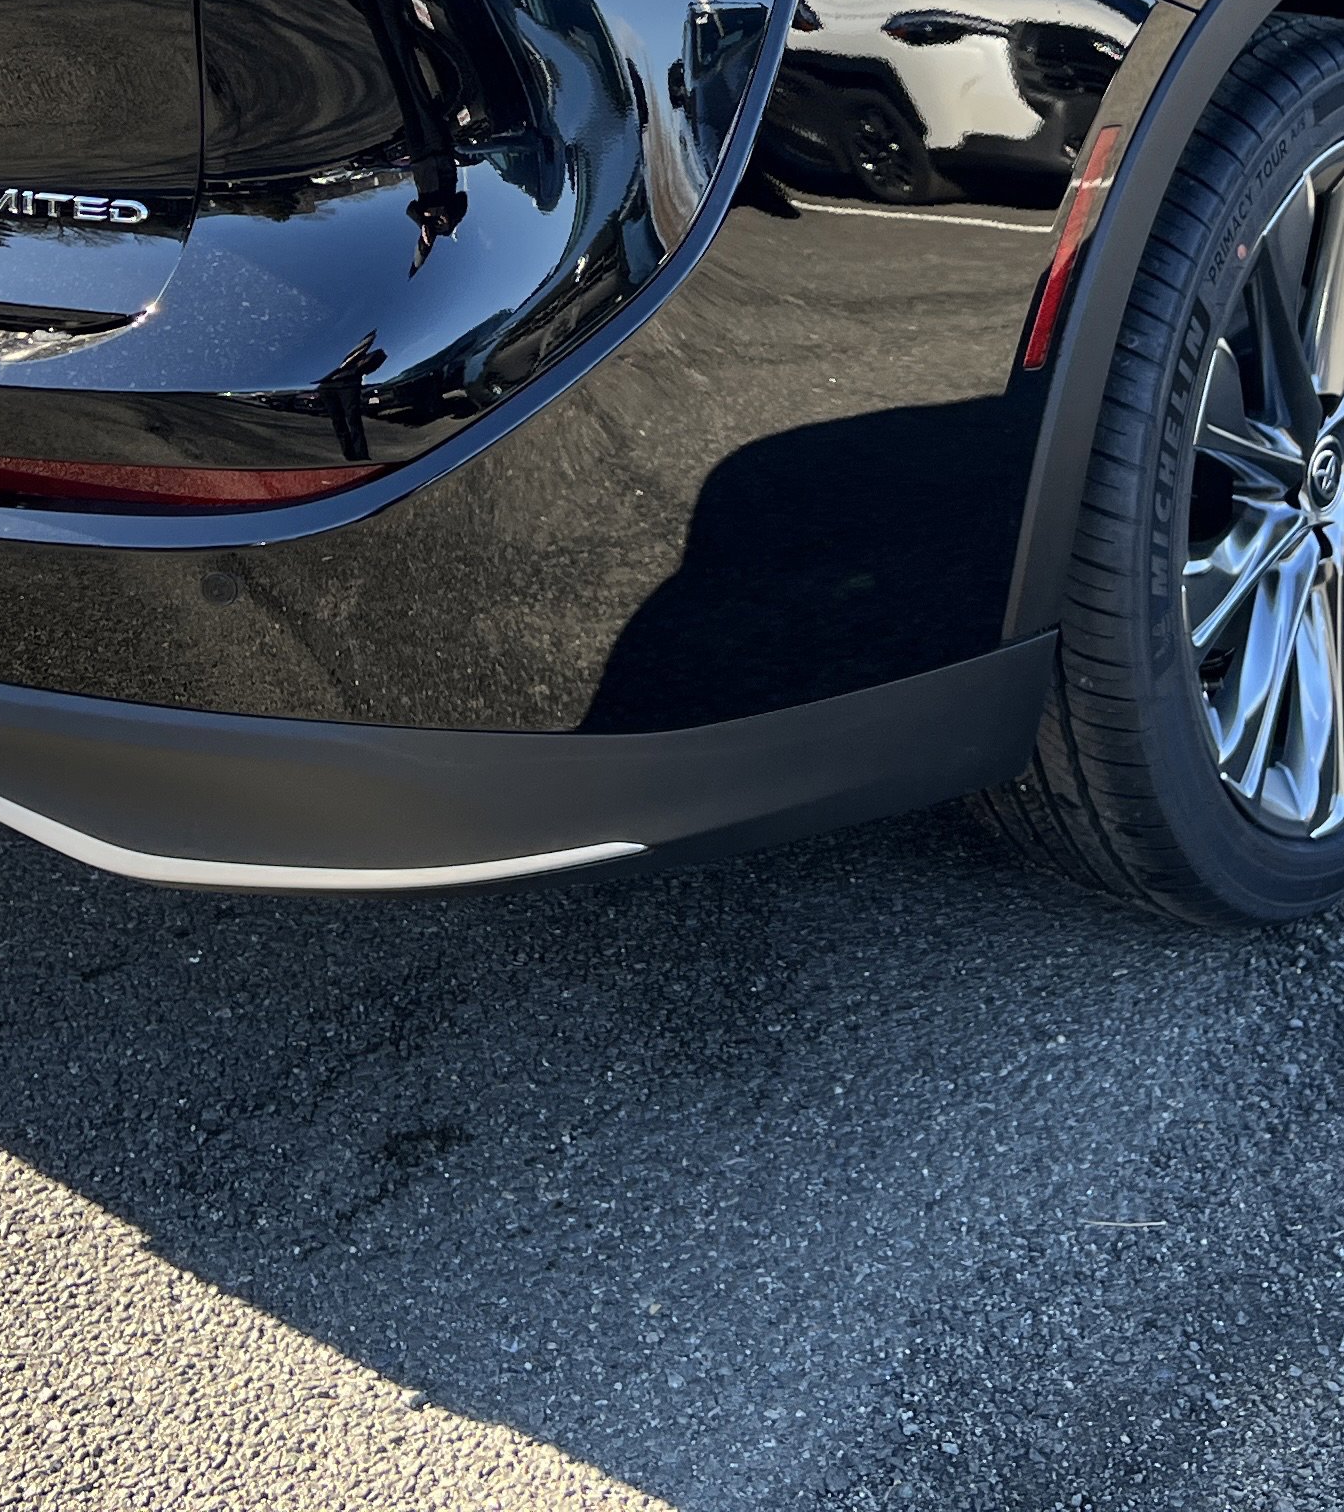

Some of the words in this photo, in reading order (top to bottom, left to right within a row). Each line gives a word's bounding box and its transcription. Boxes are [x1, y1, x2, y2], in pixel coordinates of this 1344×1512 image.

[1208, 188, 1254, 285] PRIMACY
[1256, 139, 1289, 188] TOUR
[1150, 315, 1206, 597] MICHELIN
